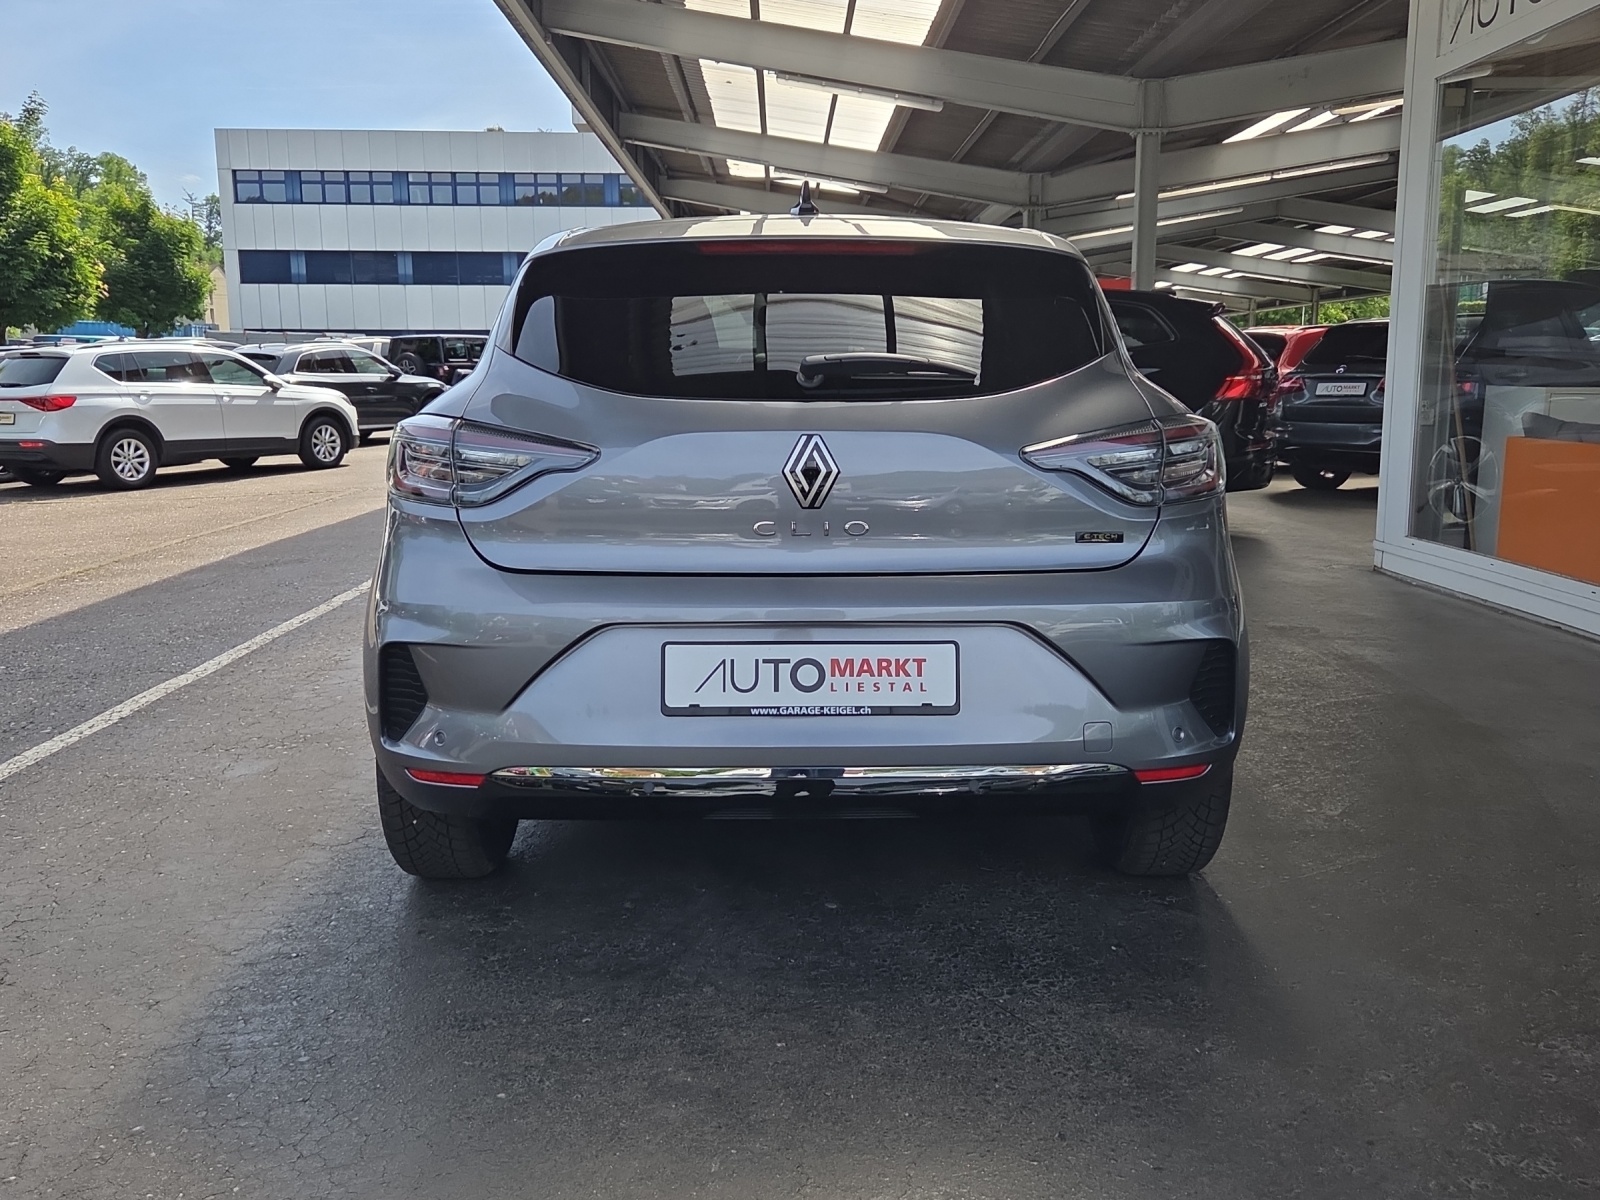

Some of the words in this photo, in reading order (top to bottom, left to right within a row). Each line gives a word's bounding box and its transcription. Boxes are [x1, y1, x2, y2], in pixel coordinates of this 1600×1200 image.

[753, 520, 869, 536] CLIO
[694, 657, 826, 693] AUTO
[830, 658, 927, 677] MARKT
[830, 682, 927, 692] LIESTAL
[750, 706, 872, 715] www.GARAGE-KEIGEL.ch
